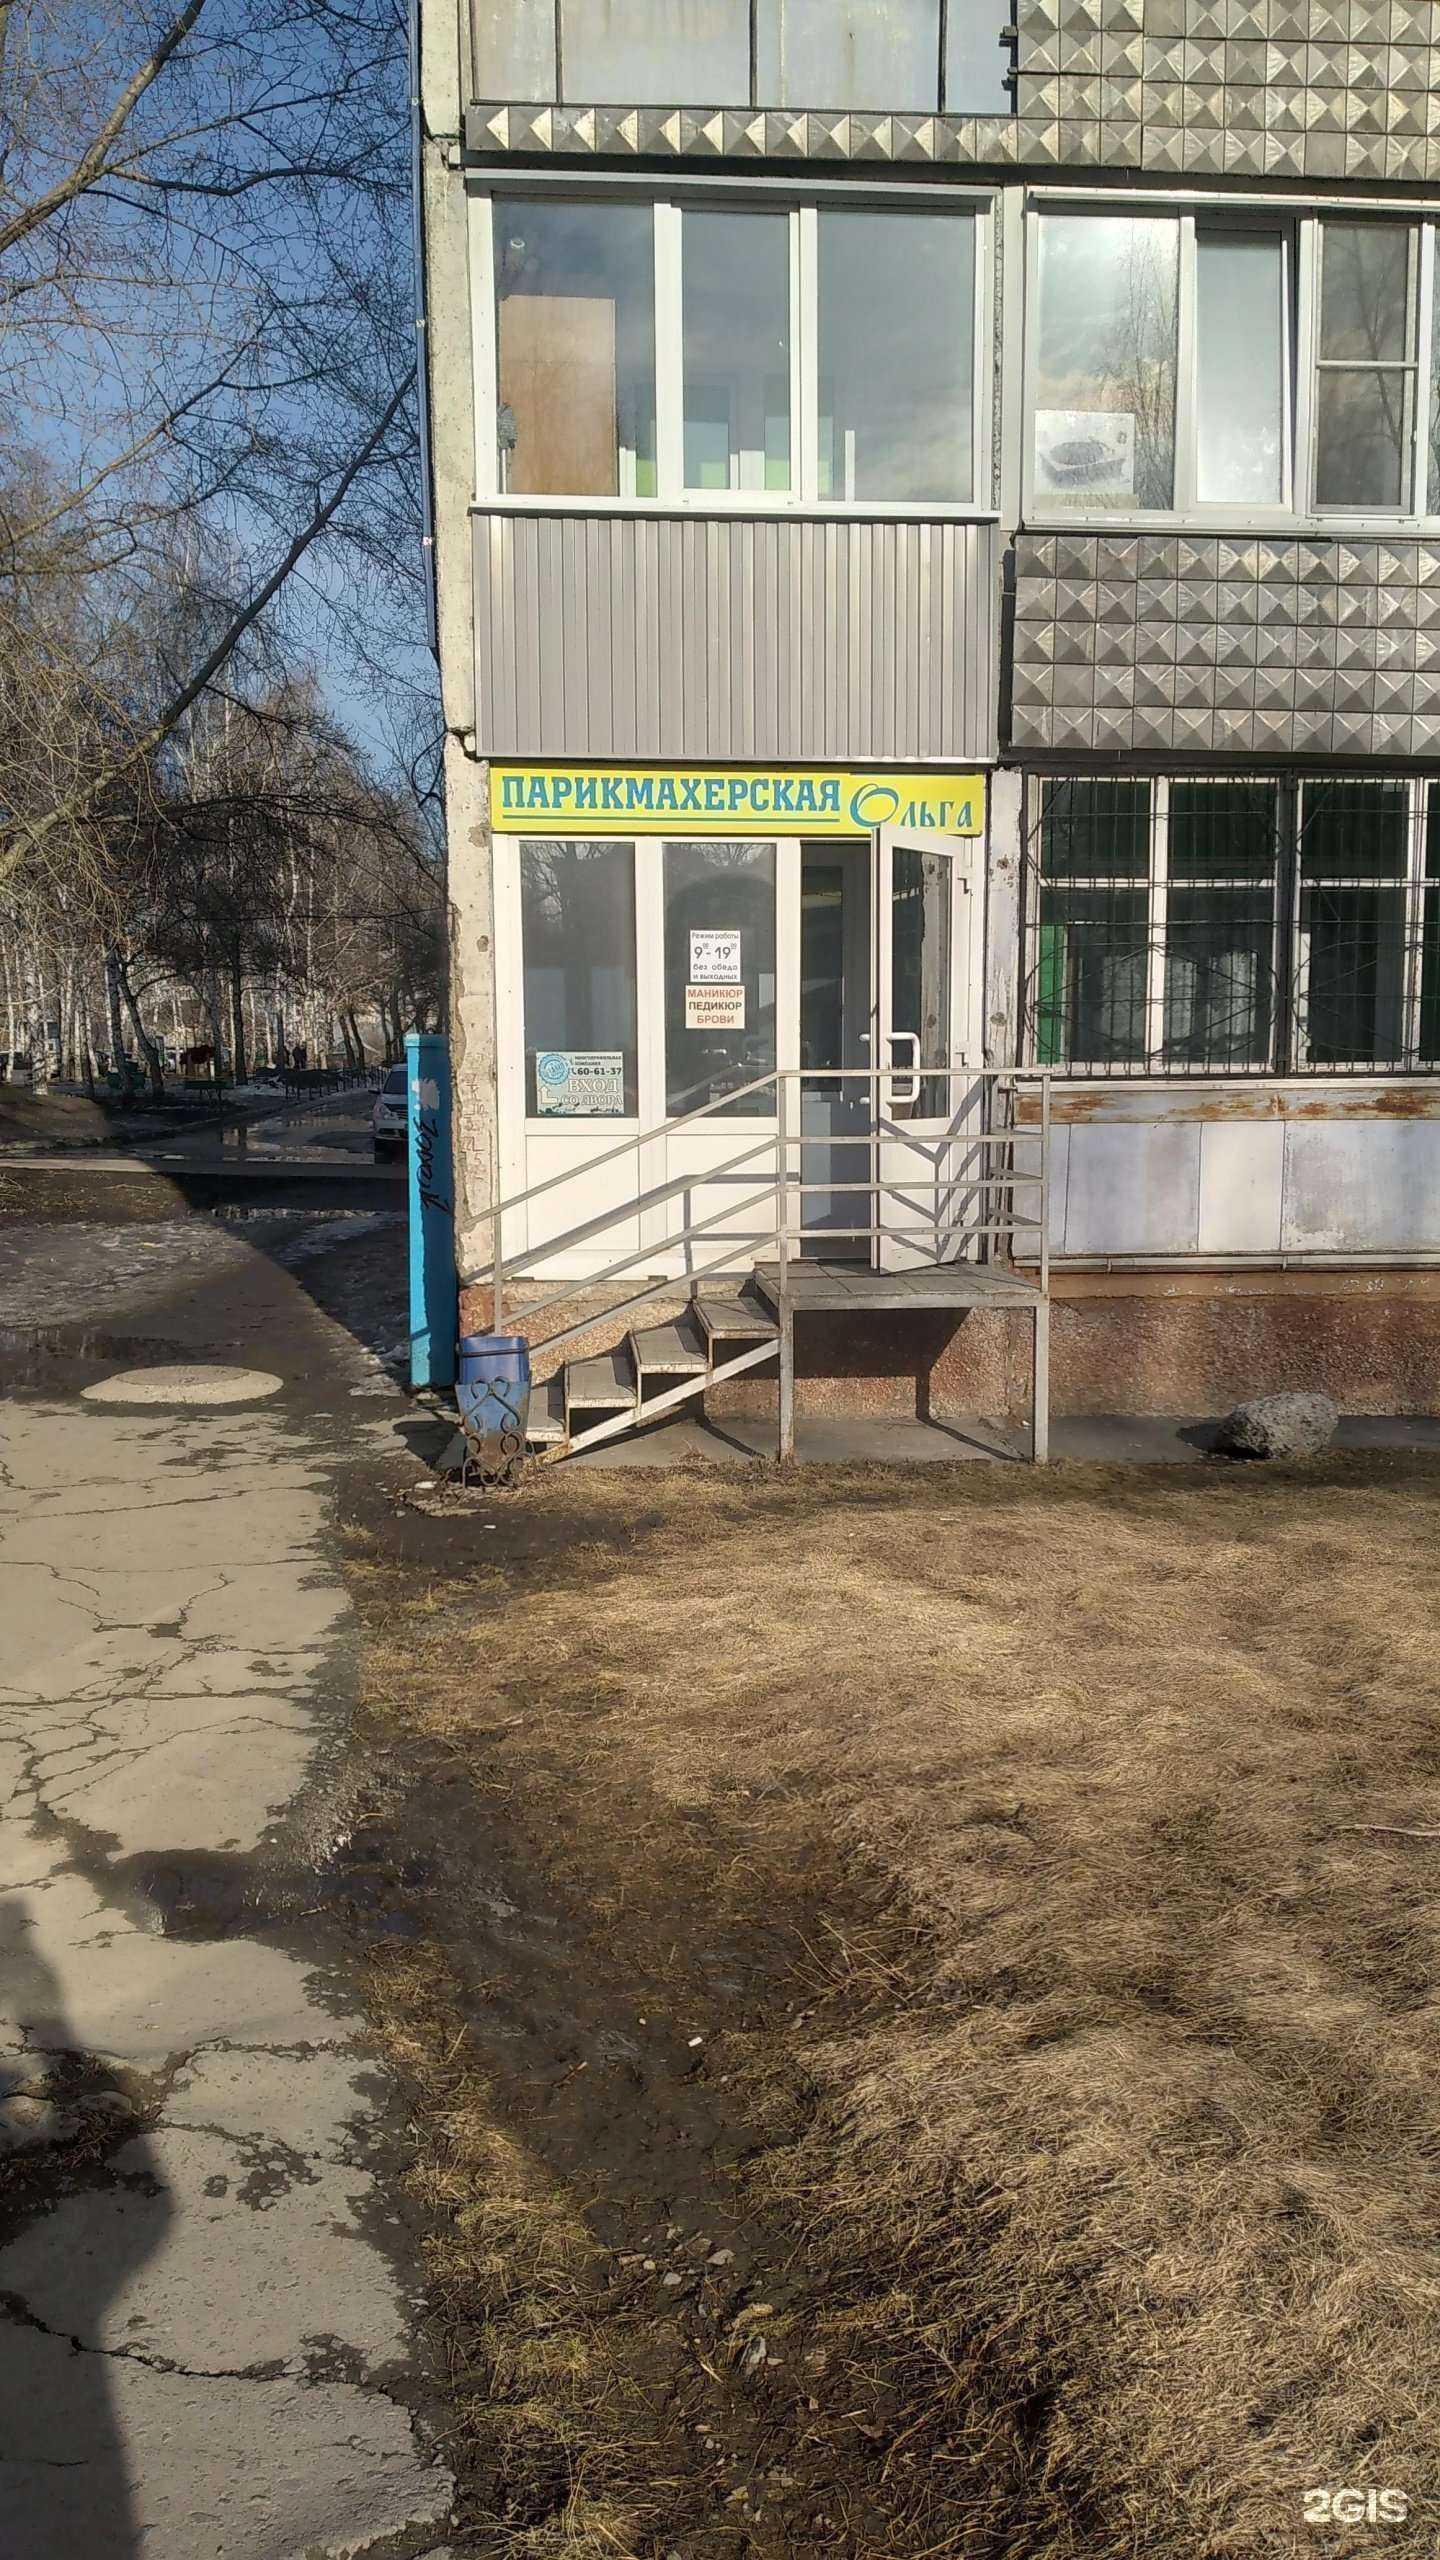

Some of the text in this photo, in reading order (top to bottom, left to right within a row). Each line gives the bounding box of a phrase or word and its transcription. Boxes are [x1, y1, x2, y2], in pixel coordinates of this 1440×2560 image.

[502, 775, 841, 812] ПАРИКМАХЕРСКАЯ
[692, 932, 739, 941] Режим работы
[712, 963, 738, 971] обеда
[687, 989, 743, 998] МАНИКЮР
[689, 1001, 742, 1012] ПЕДИКЮР
[697, 1015, 735, 1024] БРОВИ
[577, 1067, 622, 1075] 60-61-37
[568, 1079, 618, 1093] ВХОД
[561, 1095, 624, 1105] СО ДВОРА
